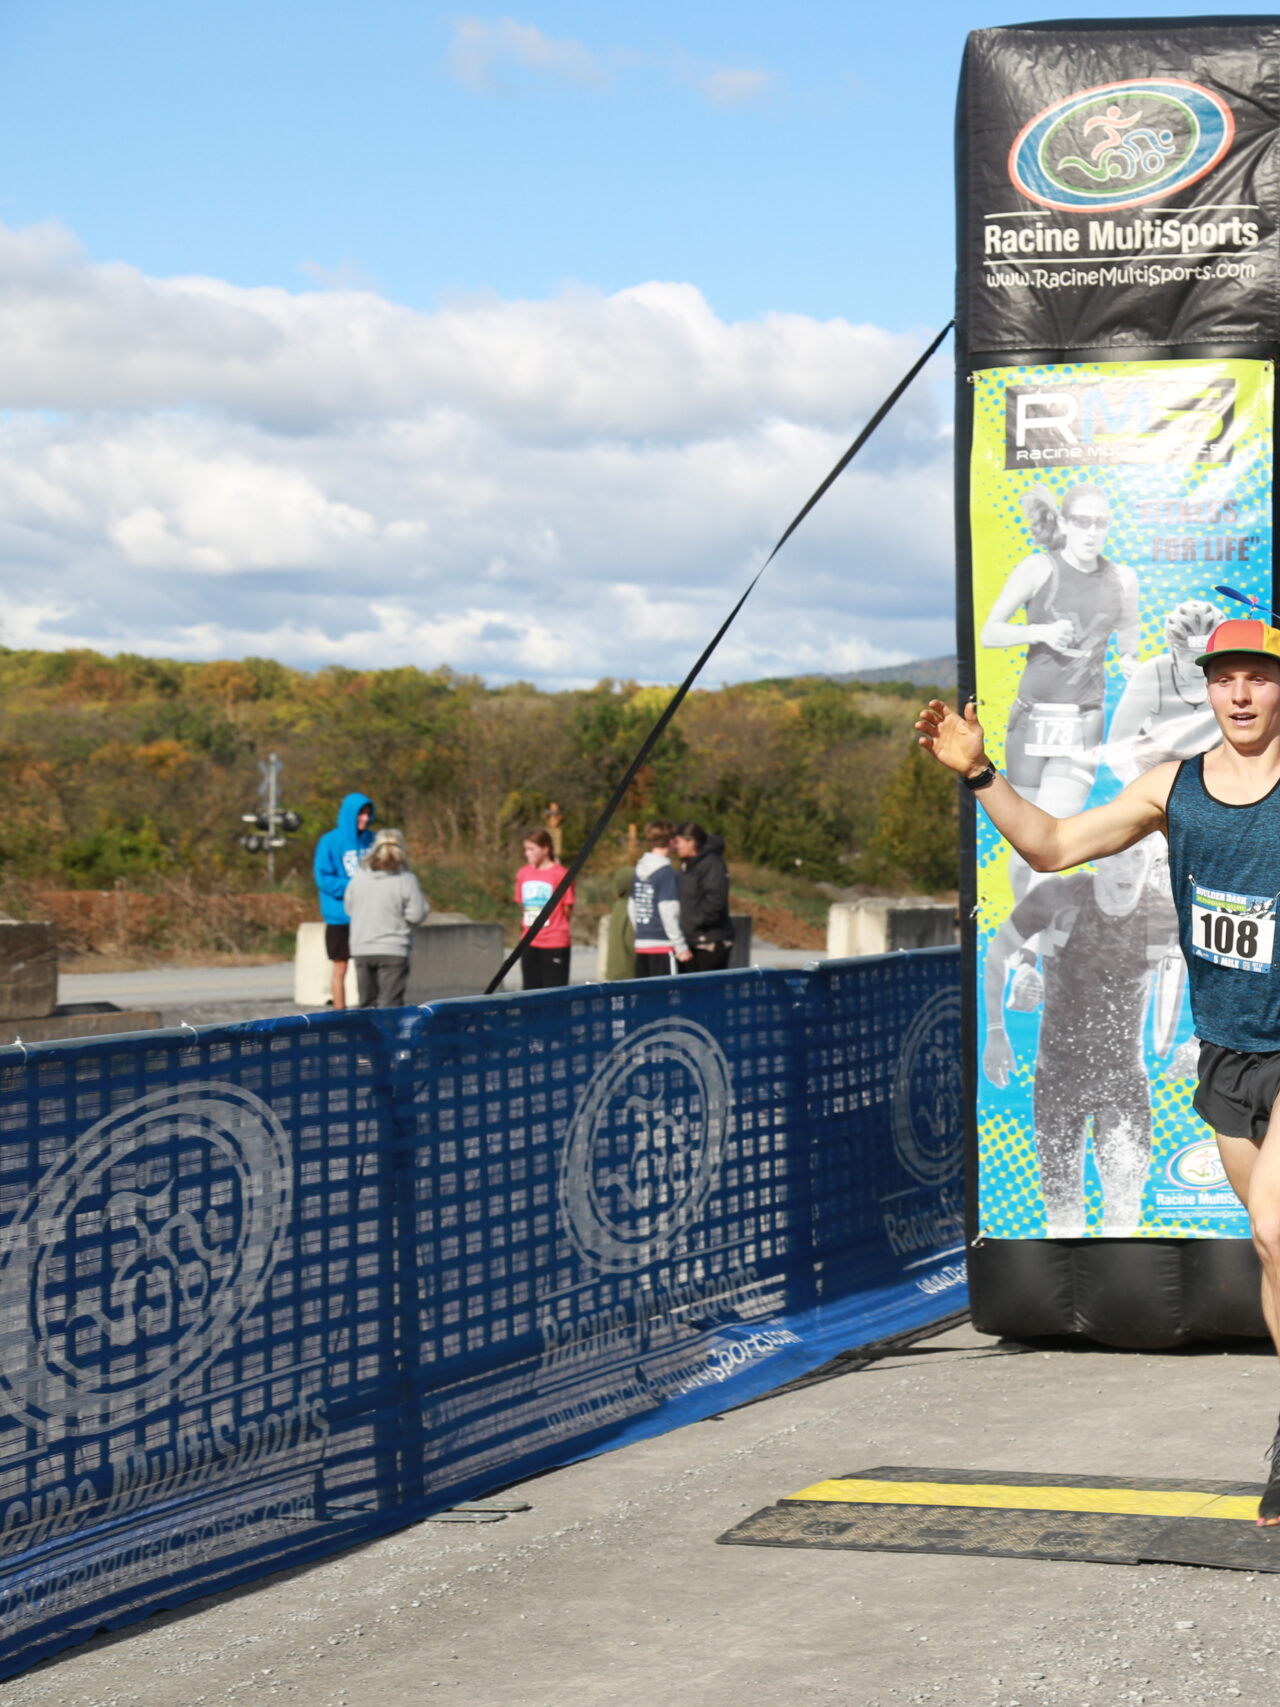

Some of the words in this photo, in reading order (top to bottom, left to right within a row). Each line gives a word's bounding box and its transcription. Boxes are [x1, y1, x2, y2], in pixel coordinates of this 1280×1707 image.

[984, 222, 1080, 254] Racine
[1088, 217, 1259, 253] MultiSports
[987, 262, 1256, 289] www.RacineMultiSports.com
[1152, 536, 1197, 561] FOR
[1201, 913, 1258, 959] 108
[1156, 1193, 1196, 1206] Racine
[1197, 1191, 1243, 1208] MultiSp
[541, 1303, 628, 1366] Racine
[634, 1260, 766, 1339] MultiSports
[107, 1391, 330, 1516] MultiSports
